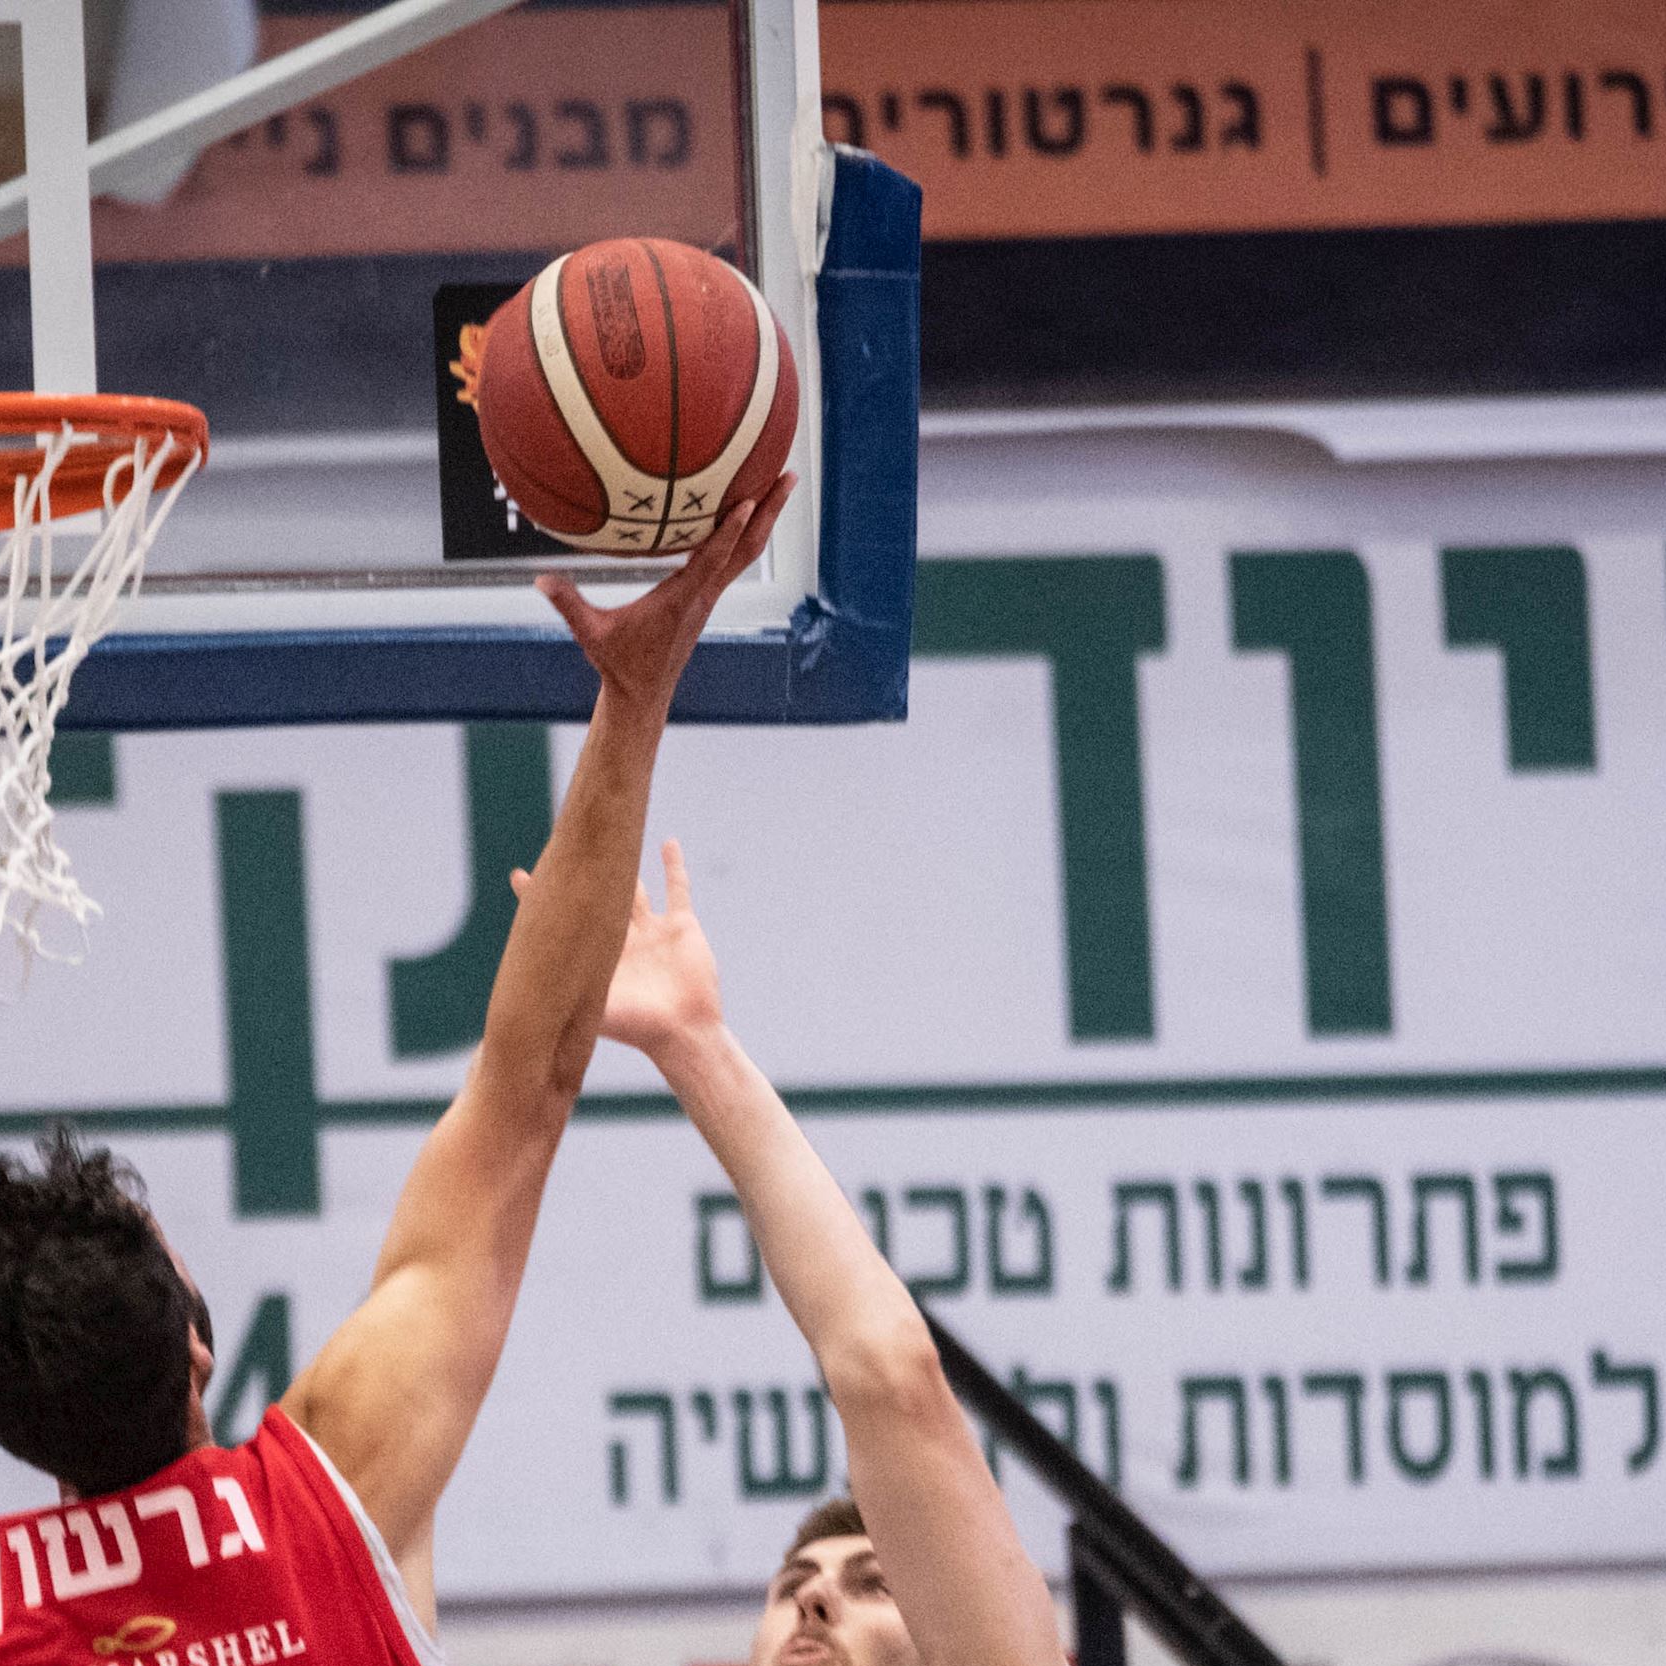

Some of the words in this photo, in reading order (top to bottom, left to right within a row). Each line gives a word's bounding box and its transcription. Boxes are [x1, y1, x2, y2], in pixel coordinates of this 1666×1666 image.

[388, 95, 696, 174] מבנים
[1106, 1167, 1562, 1298] פתרונות
[1173, 1350, 1663, 1490] למוסדות
